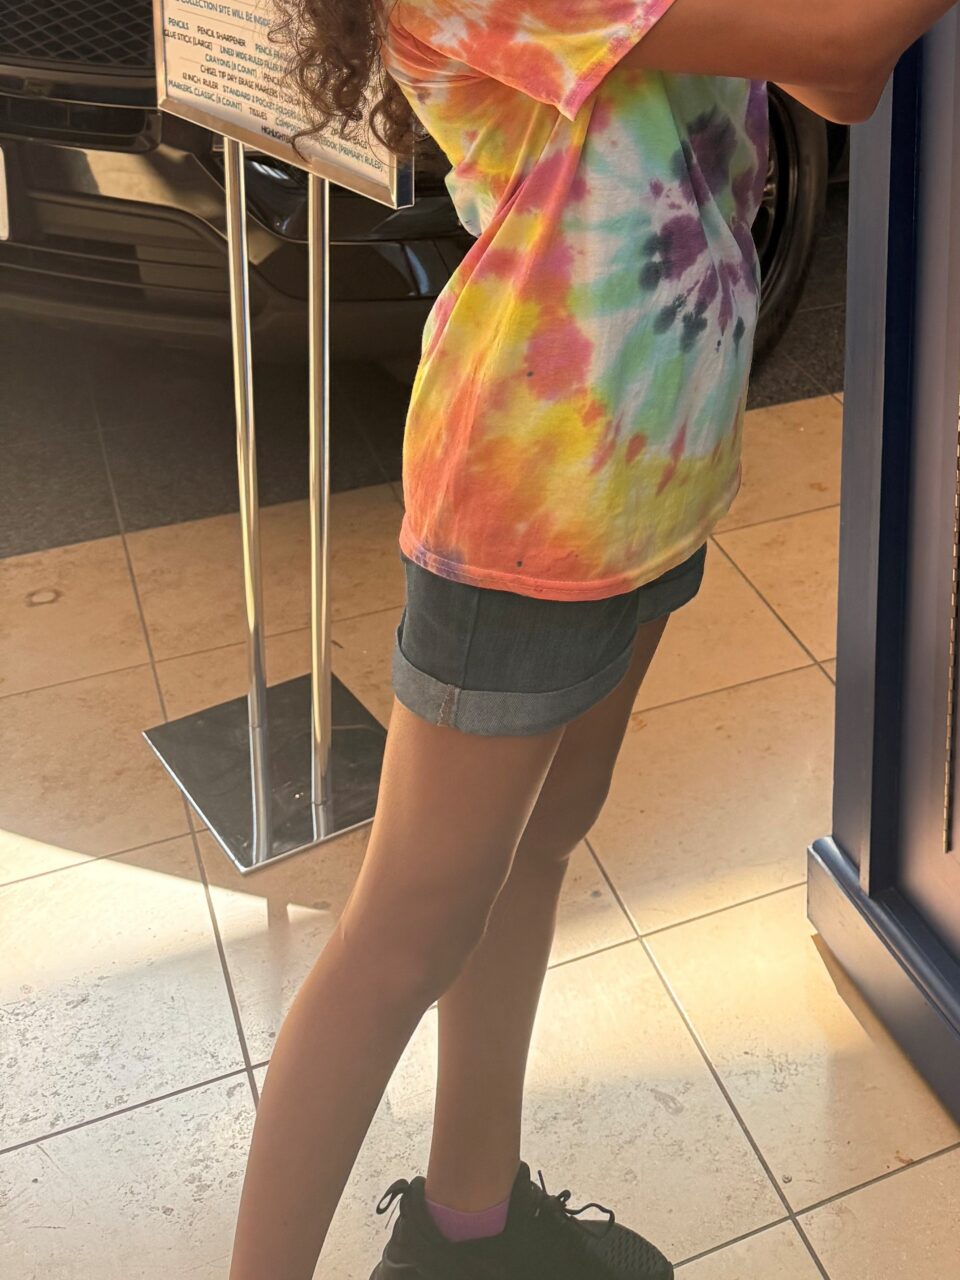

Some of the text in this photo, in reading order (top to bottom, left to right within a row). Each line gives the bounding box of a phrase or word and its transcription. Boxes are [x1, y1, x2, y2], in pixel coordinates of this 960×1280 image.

[218, 4, 231, 17] SITE
[231, 8, 245, 21] WILL
[245, 11, 253, 23] BE
[168, 17, 190, 30] PENCILS
[177, 32, 193, 43] STICK
[200, 64, 217, 77] CHISEL
[218, 70, 227, 80] TIP
[187, 73, 201, 84] INCH
[202, 78, 219, 90] RULER
[222, 85, 251, 101] STANDARD
[193, 86, 216, 102] CLASSIC
